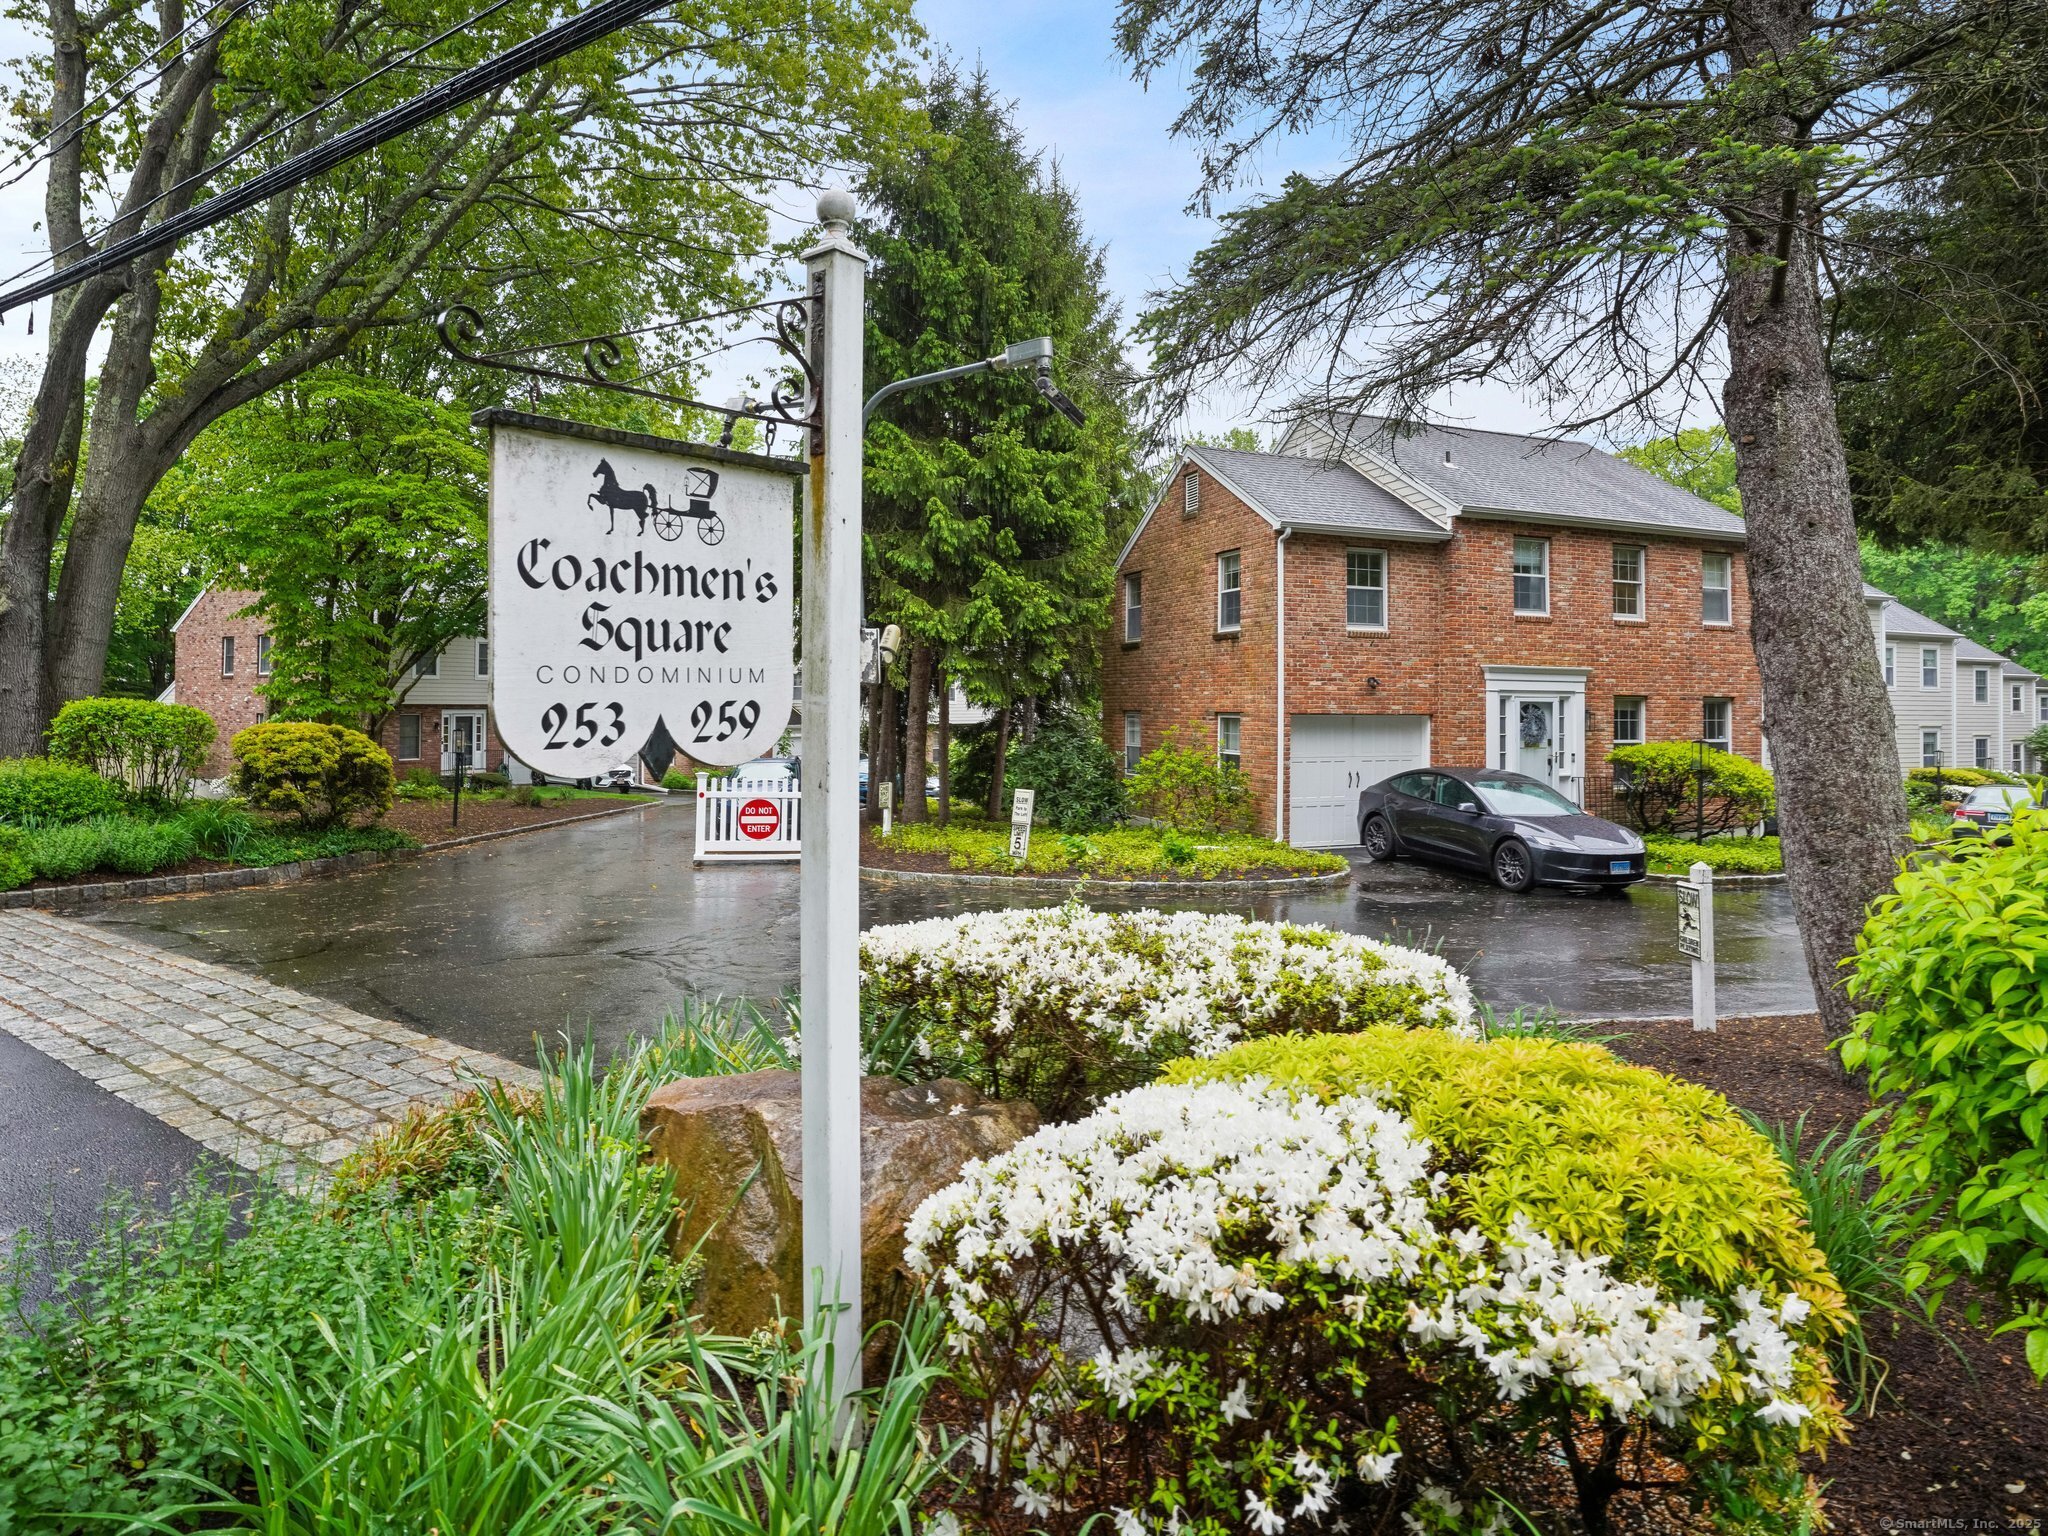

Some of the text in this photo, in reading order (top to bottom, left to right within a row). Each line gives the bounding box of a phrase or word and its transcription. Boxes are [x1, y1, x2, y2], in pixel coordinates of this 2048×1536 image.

[517, 537, 778, 603] Coachmen's
[578, 602, 732, 662] Square
[537, 665, 764, 684] CONDOMINIUM
[541, 700, 761, 751] 253 259
[1014, 837, 1021, 850] 5
